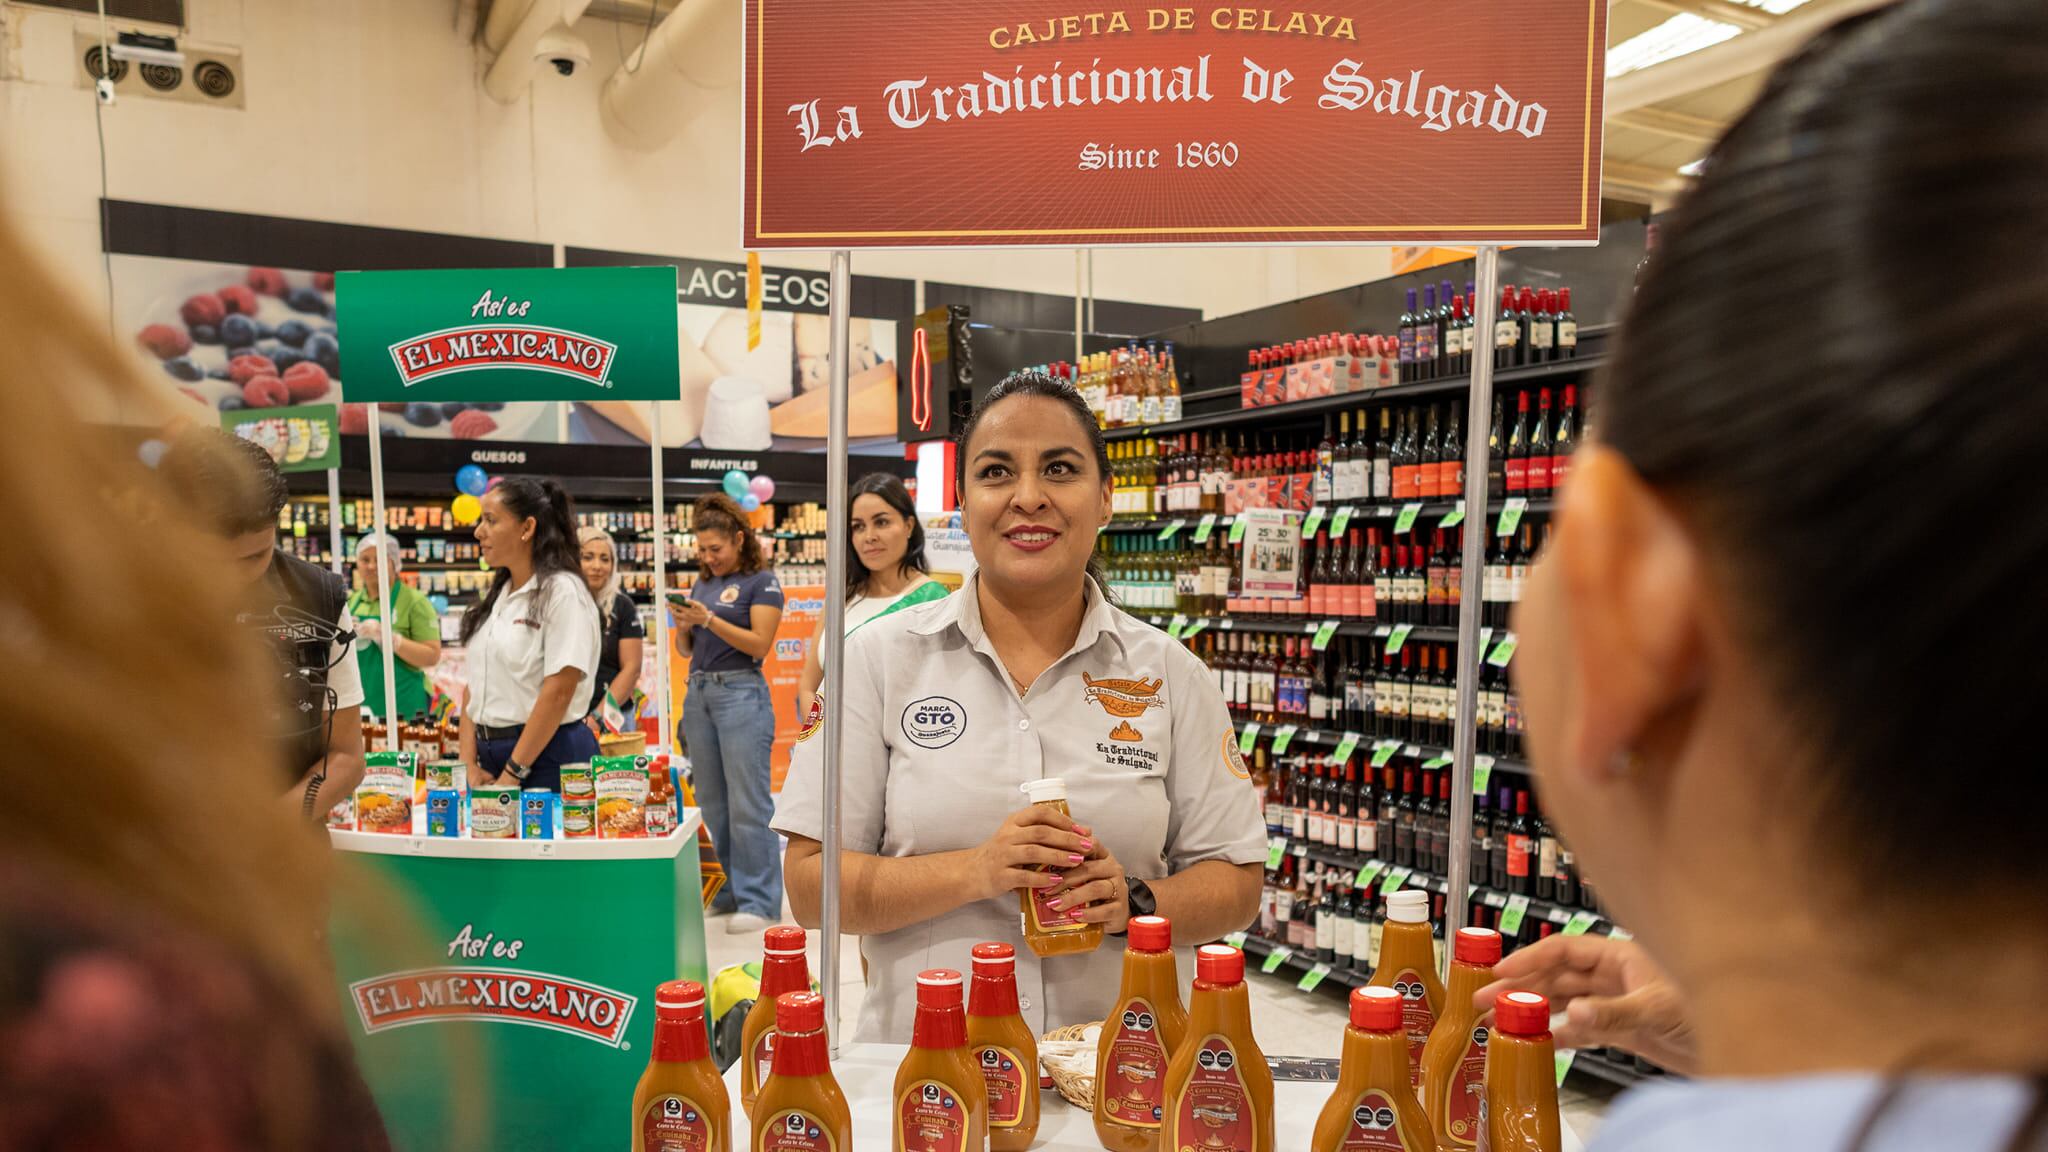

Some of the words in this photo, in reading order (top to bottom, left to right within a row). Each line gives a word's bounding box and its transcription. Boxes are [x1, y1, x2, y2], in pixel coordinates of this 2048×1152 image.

[988, 11, 1132, 51] CAJETA
[1146, 7, 1197, 33] DE
[1210, 7, 1359, 42] CELAYA
[787, 96, 864, 153] La
[1242, 56, 1295, 105] de
[1317, 58, 1548, 141] Salgado
[1078, 141, 1161, 171] Since
[1174, 141, 1240, 170] 1860
[506, 300, 532, 318] es
[403, 341, 444, 372] EL
[446, 332, 604, 371] MEXICANO
[471, 451, 526, 464] QUESOS
[690, 459, 758, 471] INFANTILES
[914, 712, 956, 725] GTO
[1096, 742, 1110, 754] La
[1110, 744, 1159, 762] Tradicional
[1105, 754, 1116, 765] de
[1116, 755, 1153, 771] Salgado
[491, 938, 524, 960] es
[365, 986, 412, 1017] EL
[417, 976, 618, 1028] MEXICANO
[987, 1051, 994, 1059] 2
[928, 1086, 935, 1094] 2
[670, 1100, 677, 1108] 2
[792, 1116, 800, 1124] 2
